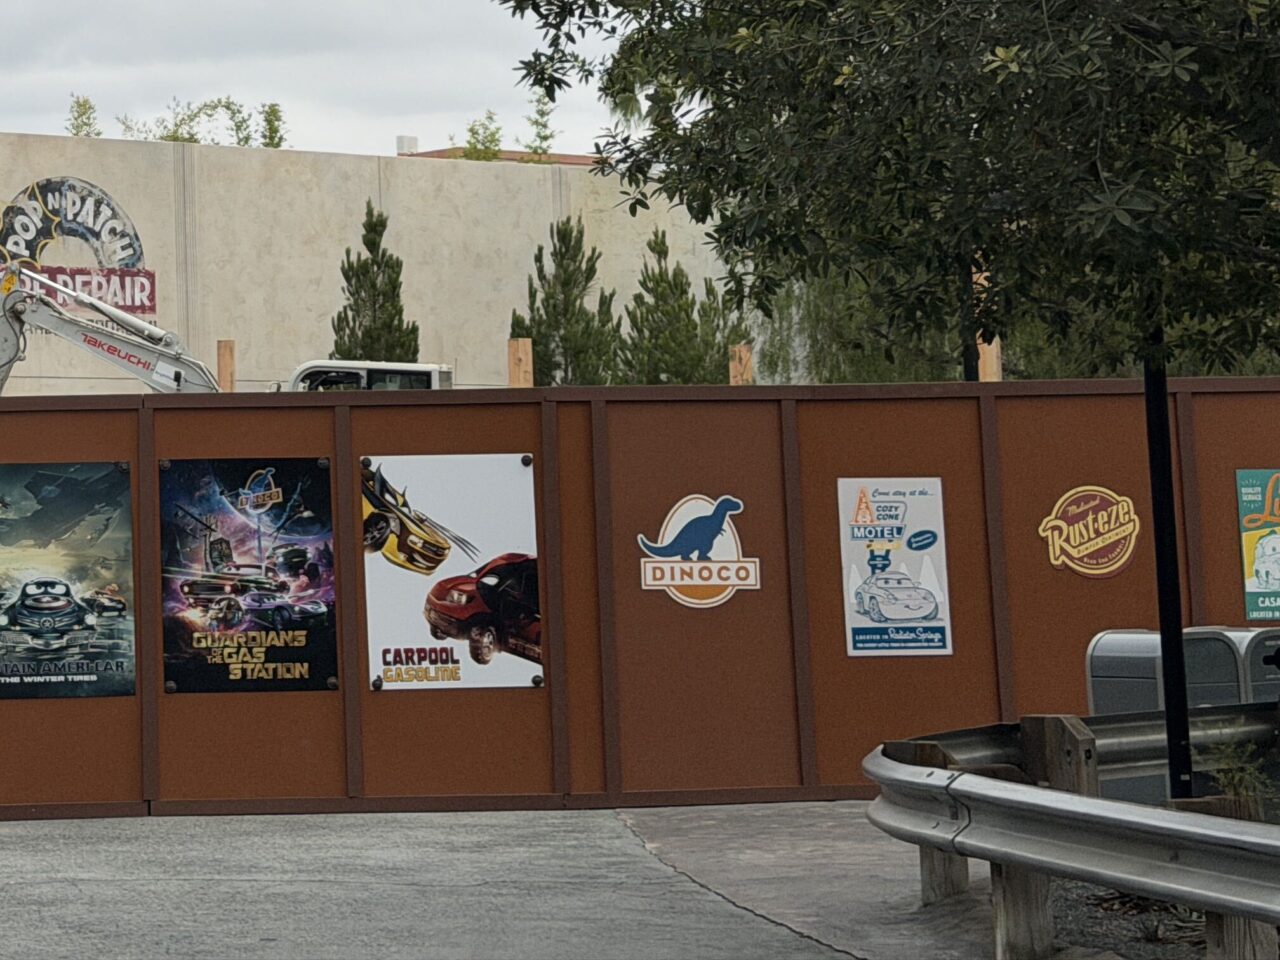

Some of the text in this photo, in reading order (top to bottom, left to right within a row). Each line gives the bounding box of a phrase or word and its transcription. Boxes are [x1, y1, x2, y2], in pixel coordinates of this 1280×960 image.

[6, 200, 43, 257] POP
[66, 191, 134, 262] PATCH
[57, 273, 151, 306] REPAIR
[853, 527, 901, 538] MOTEL
[652, 565, 750, 581] DINOCO
[192, 630, 308, 648] GUARDIANS
[207, 647, 266, 664] OF THE GAS
[382, 646, 460, 666] CARPOOL
[22, 675, 65, 683] WINTER
[67, 674, 98, 682] TIRES
[229, 662, 310, 679] STATION
[382, 666, 461, 682] GASOLINE
